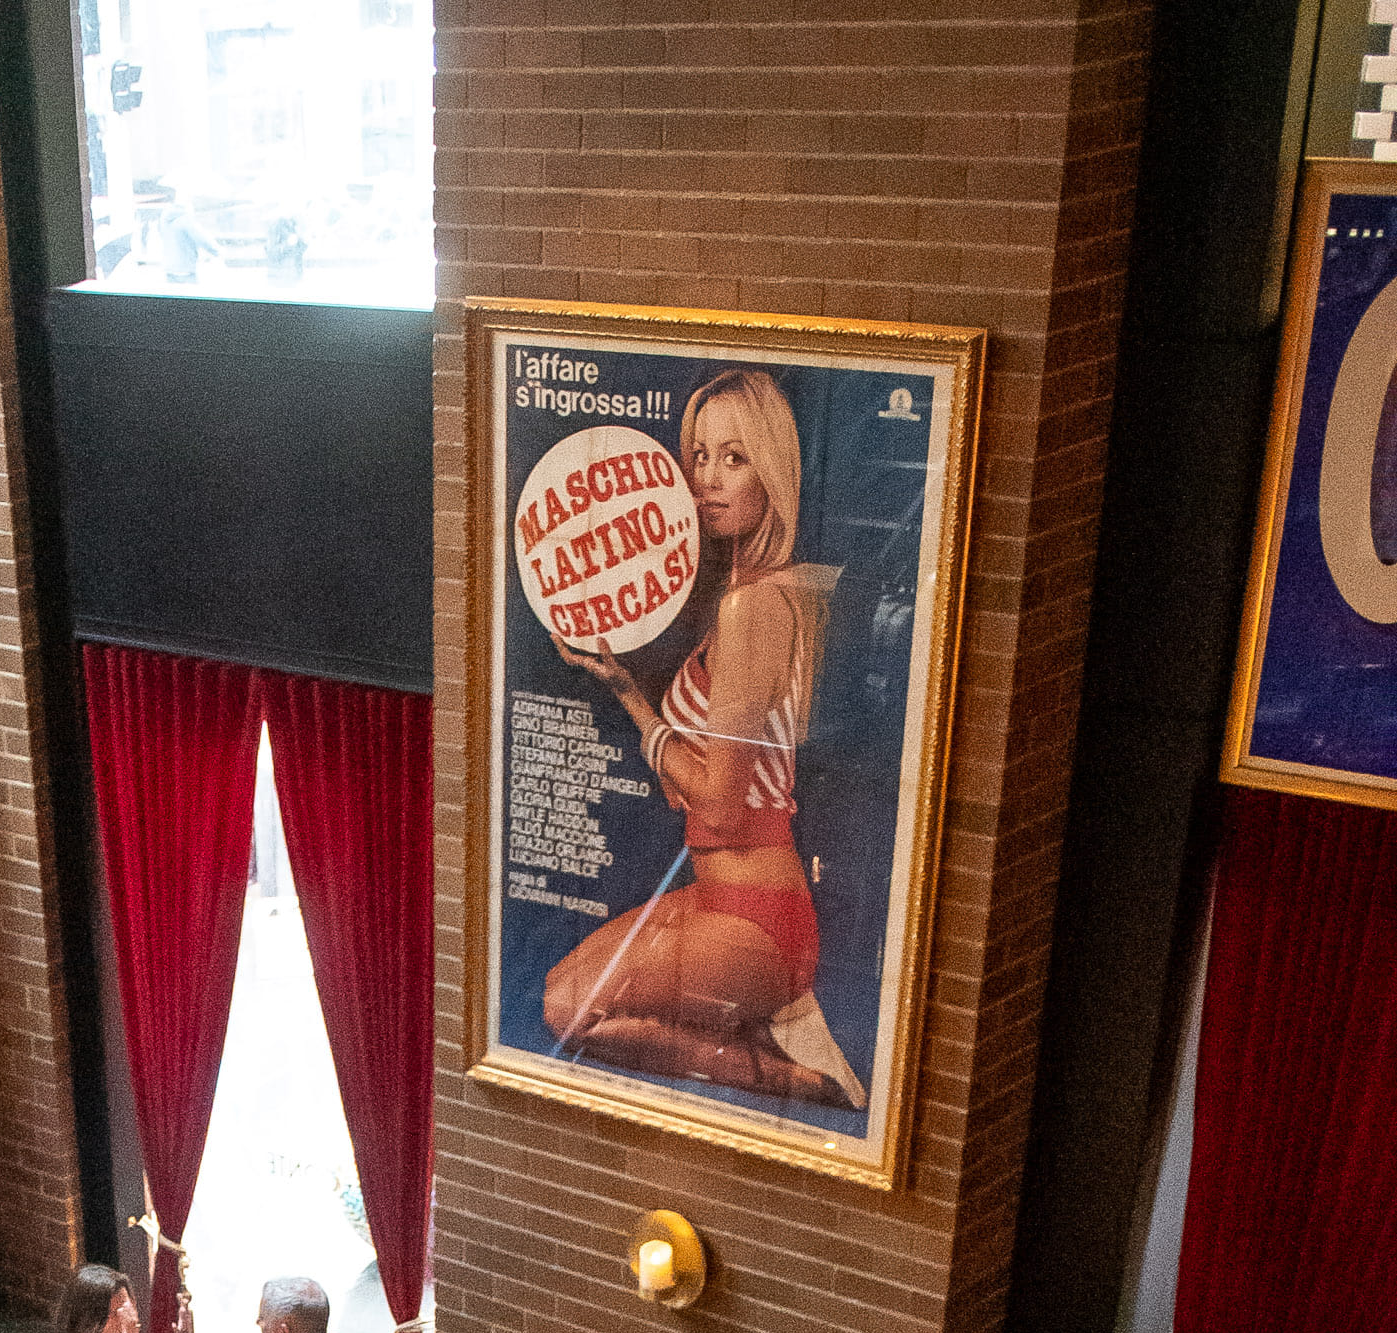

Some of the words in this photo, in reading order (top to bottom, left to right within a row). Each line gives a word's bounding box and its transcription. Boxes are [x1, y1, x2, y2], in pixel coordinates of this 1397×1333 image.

[515, 350, 598, 384] l'affare
[518, 450, 675, 556] MASCHIO
[549, 551, 695, 640] CERCASI
[511, 714, 540, 731] GINO
